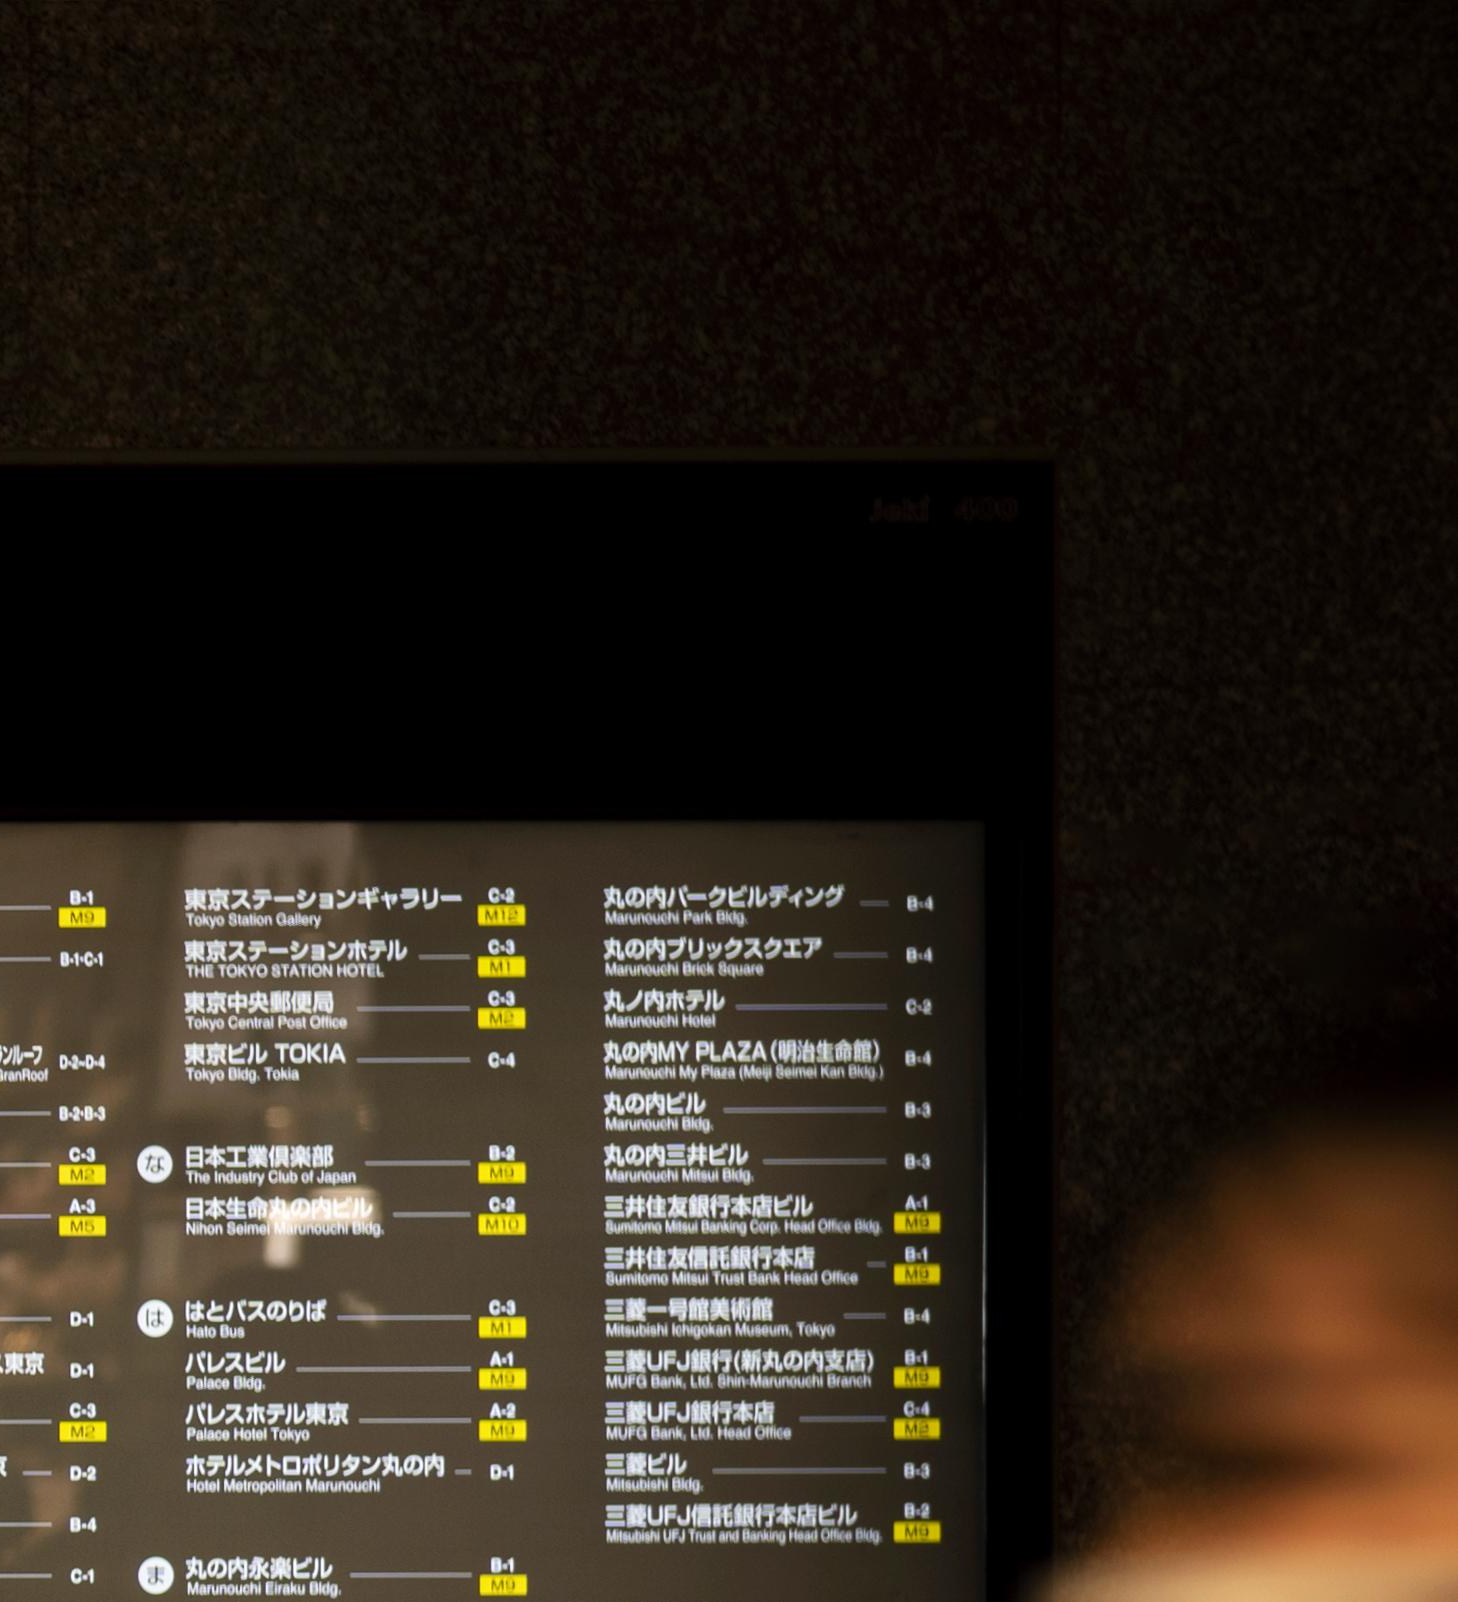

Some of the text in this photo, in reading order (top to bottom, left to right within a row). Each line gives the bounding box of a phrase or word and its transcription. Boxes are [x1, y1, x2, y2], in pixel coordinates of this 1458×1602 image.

[69, 889, 94, 907] B-1
[184, 888, 464, 911] 東京ステーションギャラリー
[67, 911, 95, 924] M9
[185, 913, 322, 929] Tokyo Station Gallery
[601, 935, 826, 962] 丸の内ブリックスクエア
